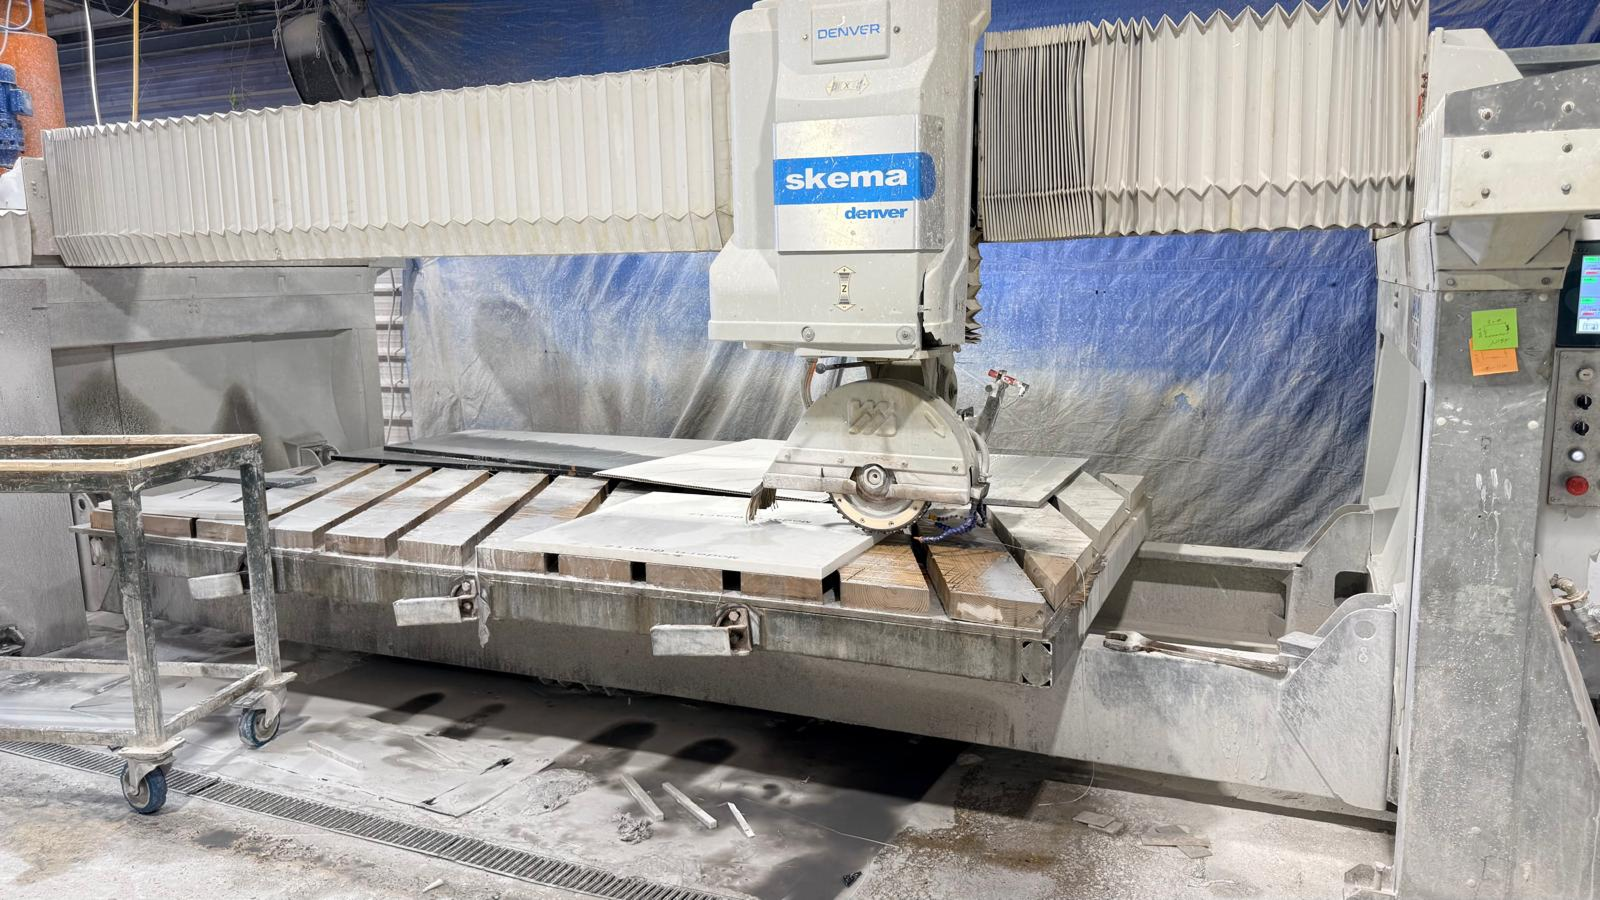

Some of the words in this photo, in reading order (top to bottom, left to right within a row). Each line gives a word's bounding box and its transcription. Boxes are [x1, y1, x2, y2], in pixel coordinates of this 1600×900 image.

[817, 24, 880, 39] DENVER
[785, 167, 908, 190] skema
[844, 207, 908, 219] denver
[841, 284, 848, 293] Z
